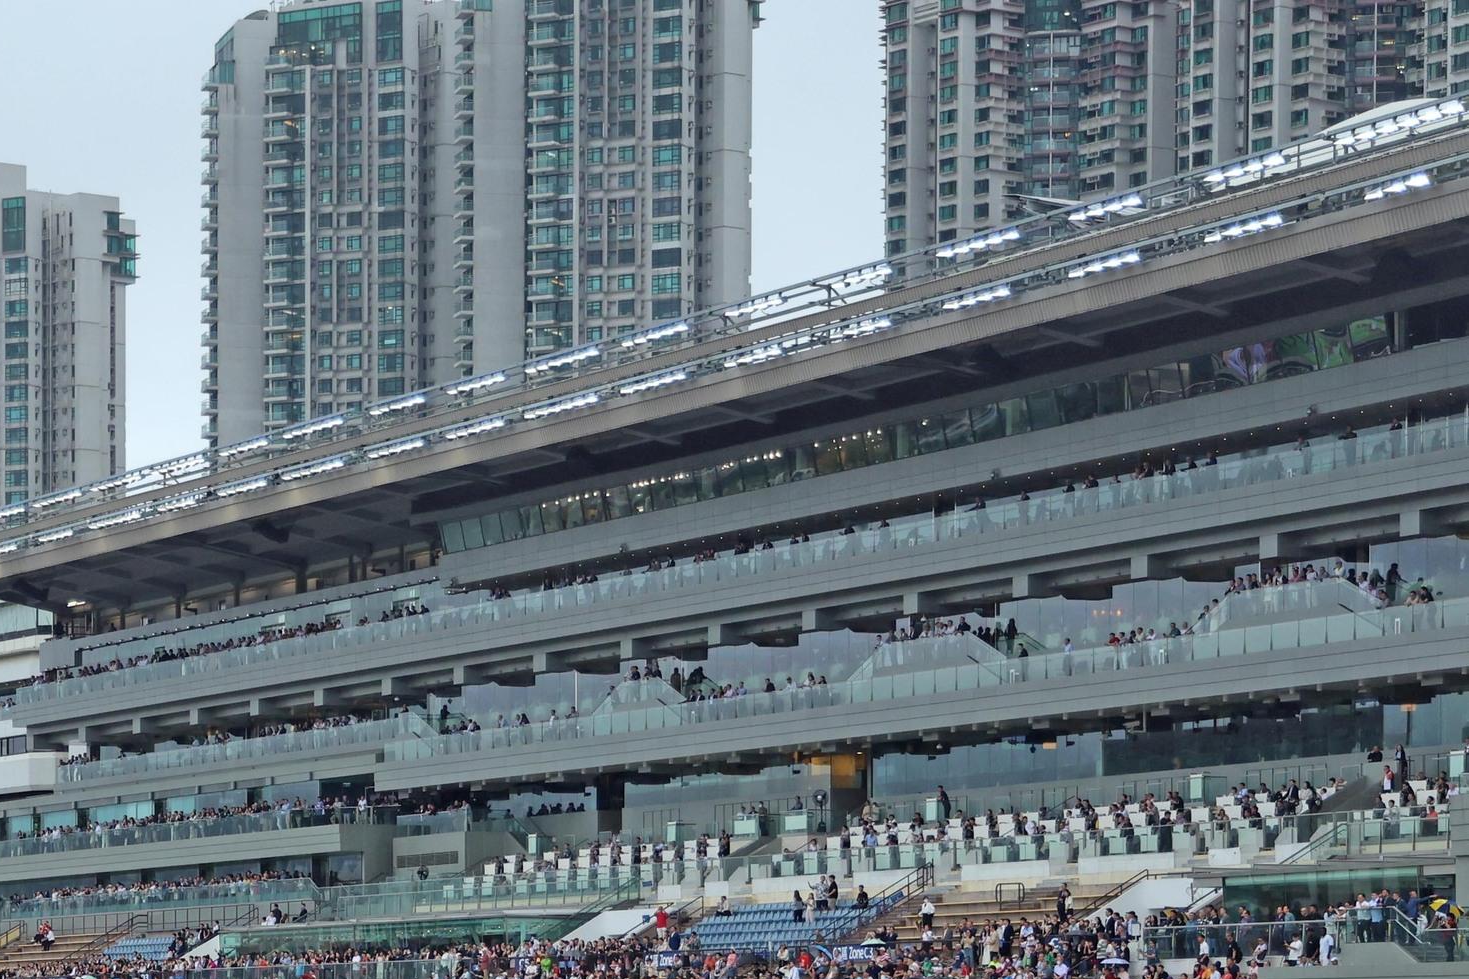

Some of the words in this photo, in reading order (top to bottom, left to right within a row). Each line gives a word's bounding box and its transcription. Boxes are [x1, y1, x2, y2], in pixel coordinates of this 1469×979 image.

[849, 946, 864, 960] Zone
[864, 946, 874, 959] C3
[659, 954, 673, 967] Zone
